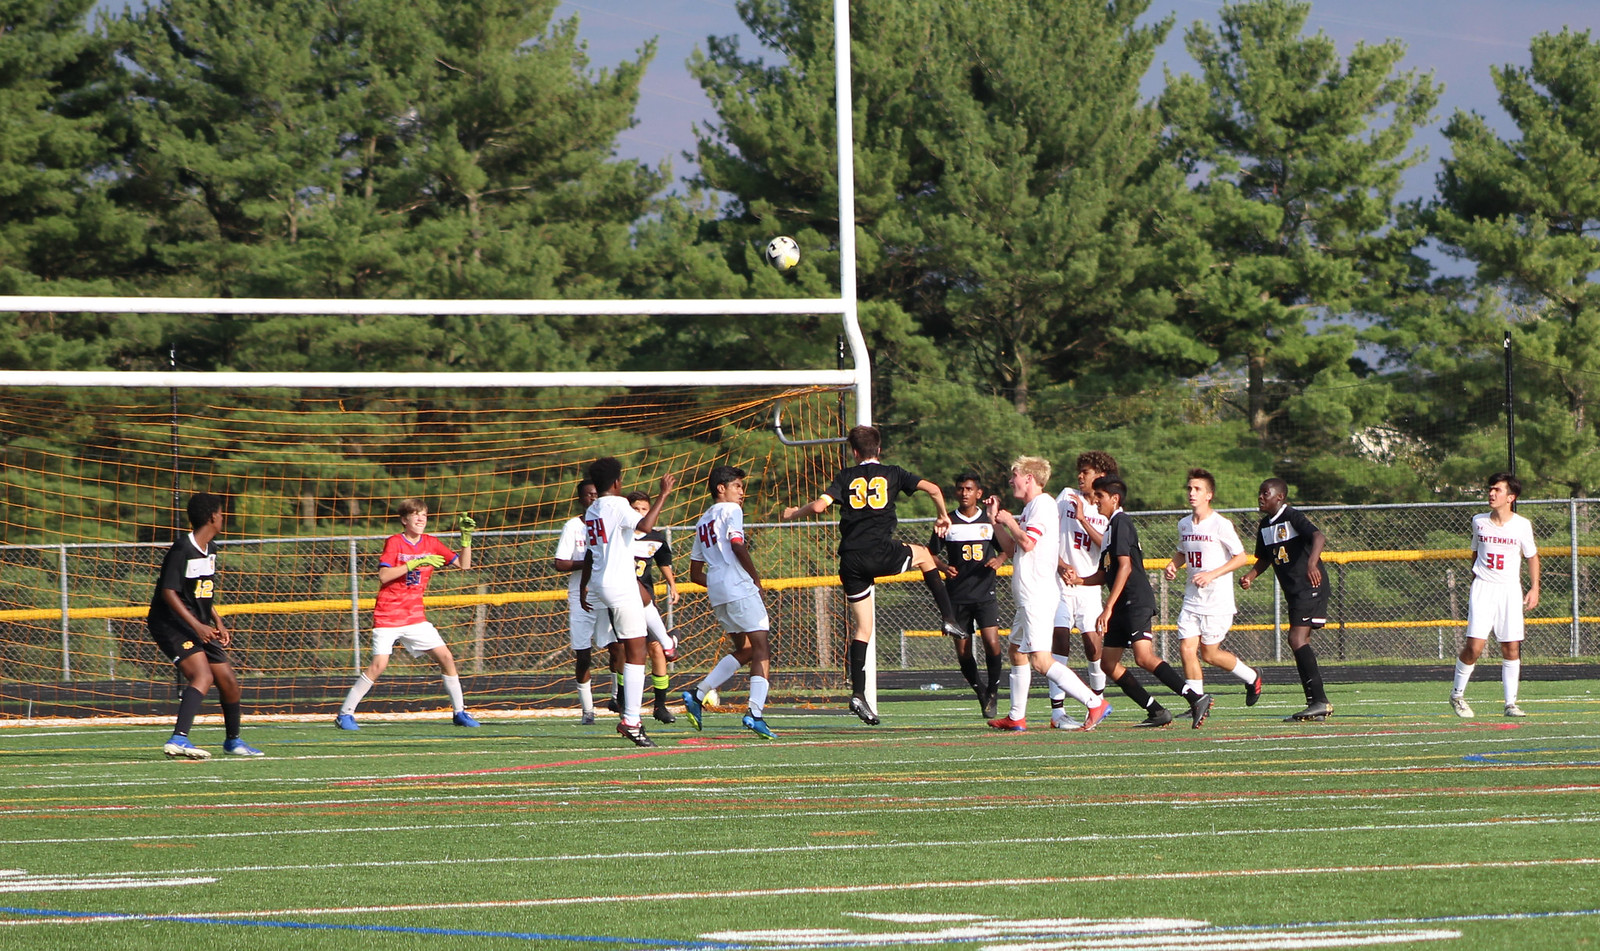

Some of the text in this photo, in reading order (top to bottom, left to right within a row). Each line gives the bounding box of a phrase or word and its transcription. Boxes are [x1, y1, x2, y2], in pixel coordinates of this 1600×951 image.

[849, 476, 888, 510] 33
[585, 518, 608, 546] 34
[1073, 531, 1091, 552] 54
[962, 544, 984, 561] 35
[1187, 551, 1202, 568] 48
[1486, 553, 1505, 570] 36
